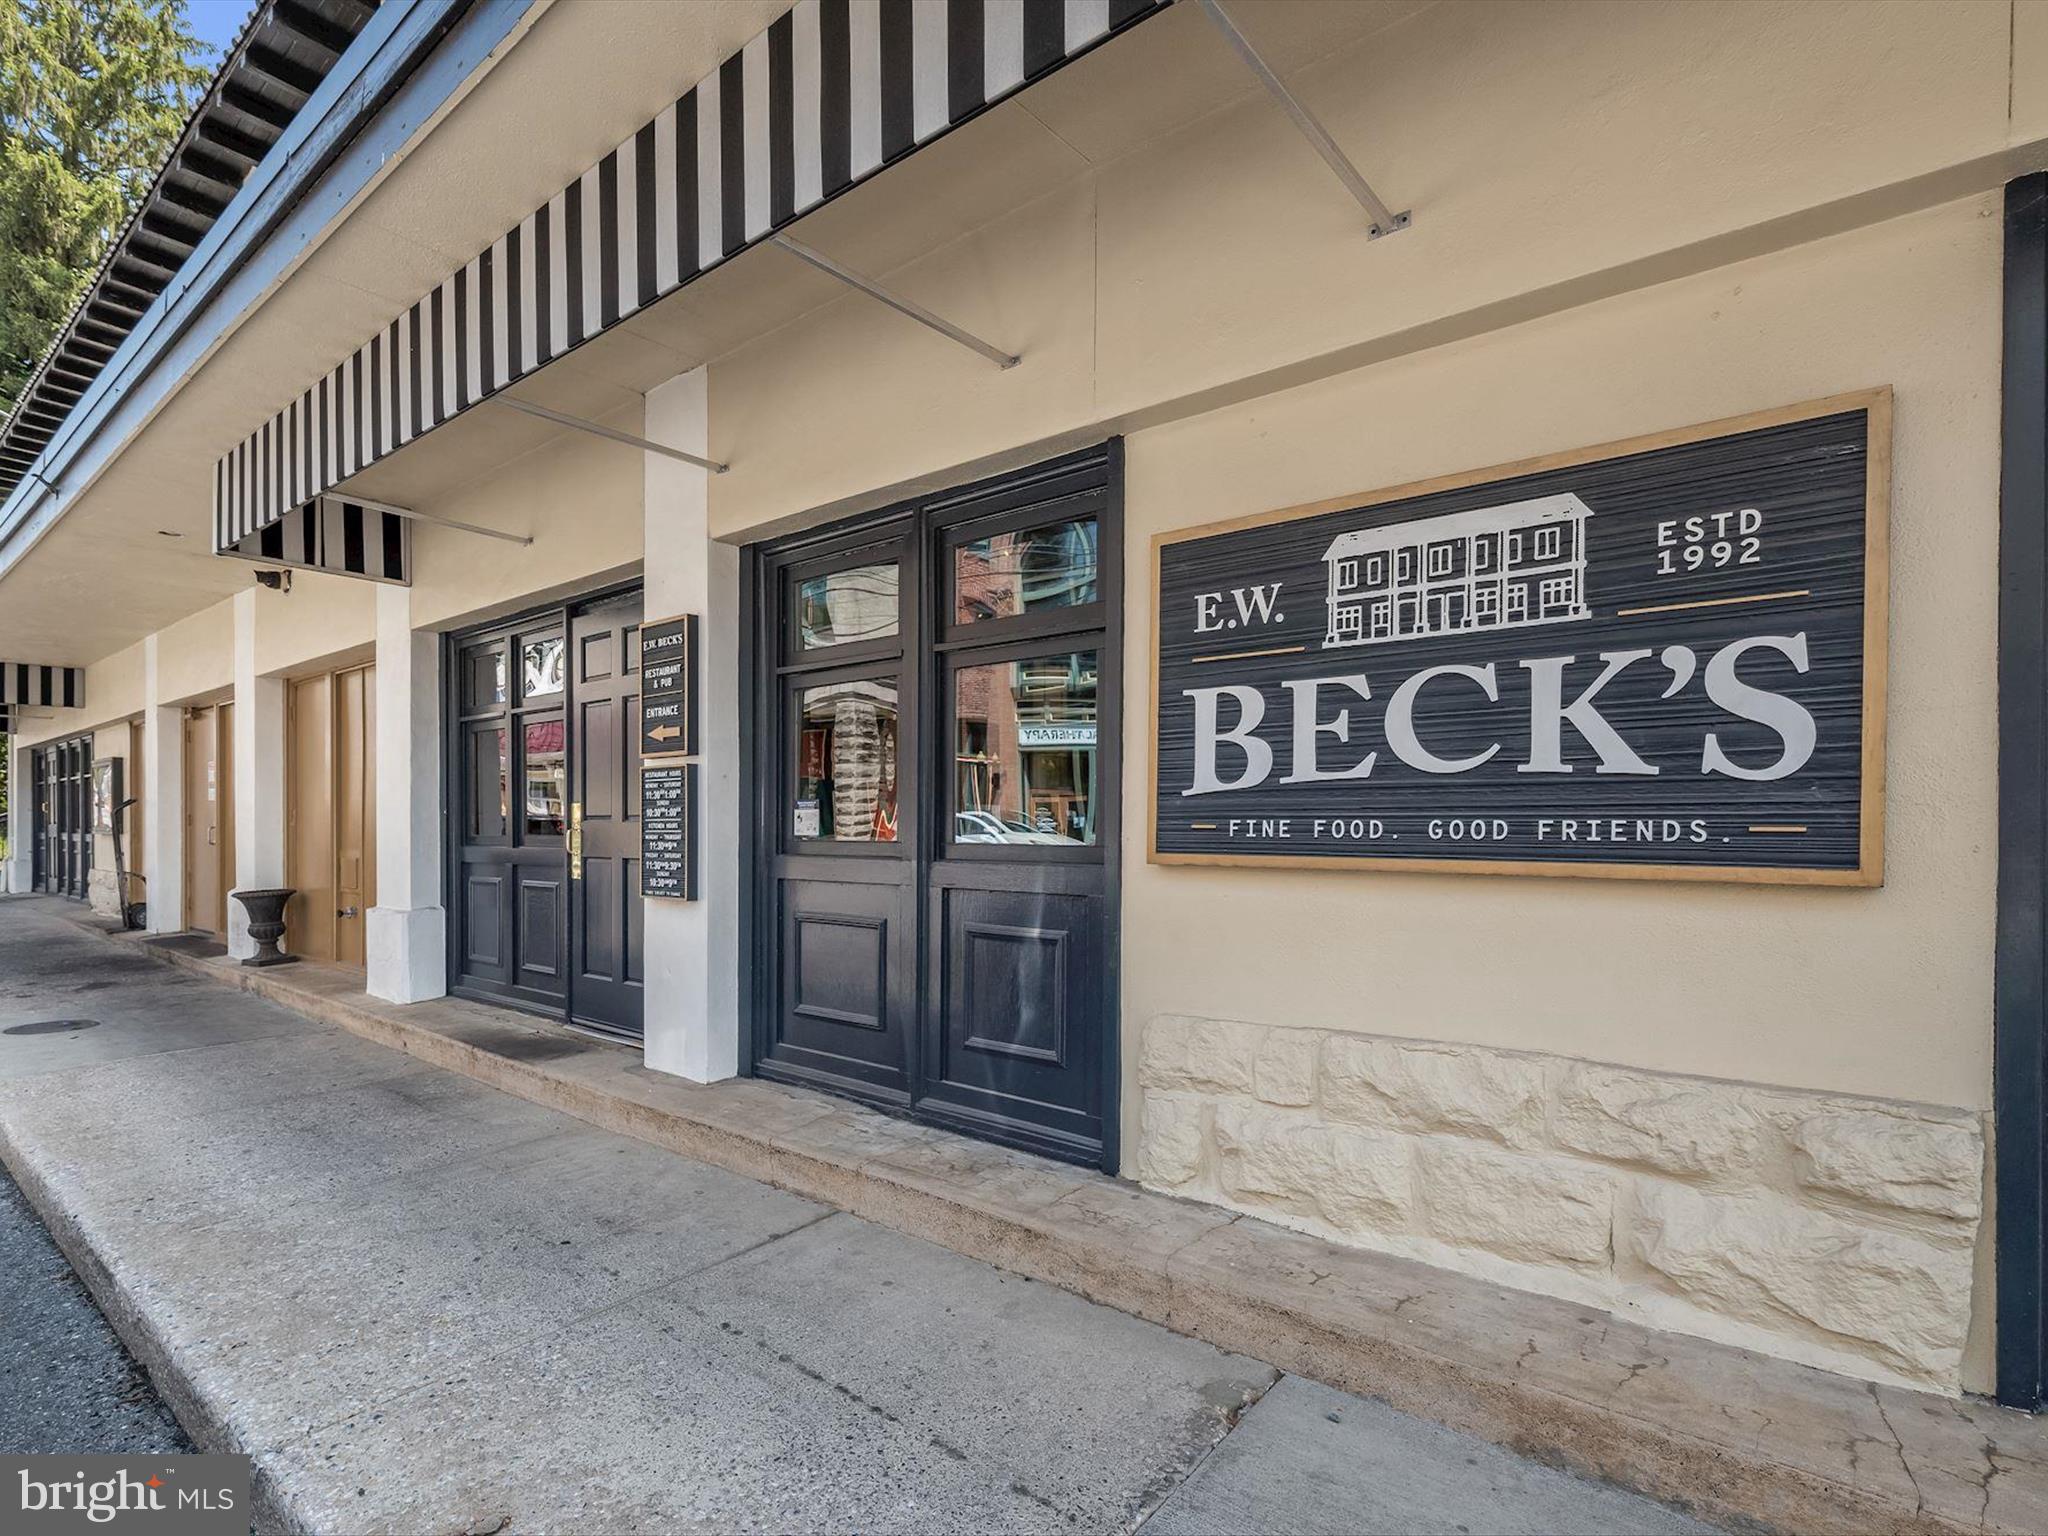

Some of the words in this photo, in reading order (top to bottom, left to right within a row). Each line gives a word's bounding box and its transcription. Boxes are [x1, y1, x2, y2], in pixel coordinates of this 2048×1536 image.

[1657, 508, 1762, 547] ESTD
[1656, 536, 1761, 575] 1992
[1193, 582, 1285, 634] E.W.
[658, 634, 683, 647] BECK'S
[645, 664, 681, 678] RESTAURANT
[653, 679, 658, 689] &
[660, 677, 673, 688] PUB
[647, 705, 678, 718] ENTRANCE
[1181, 631, 1818, 798] BECK'S
[1229, 819, 1291, 838] FINE
[1314, 819, 1399, 840] FOOD.
[1428, 819, 1508, 840] GOOD
[1538, 819, 1731, 843] FRIENDS.
